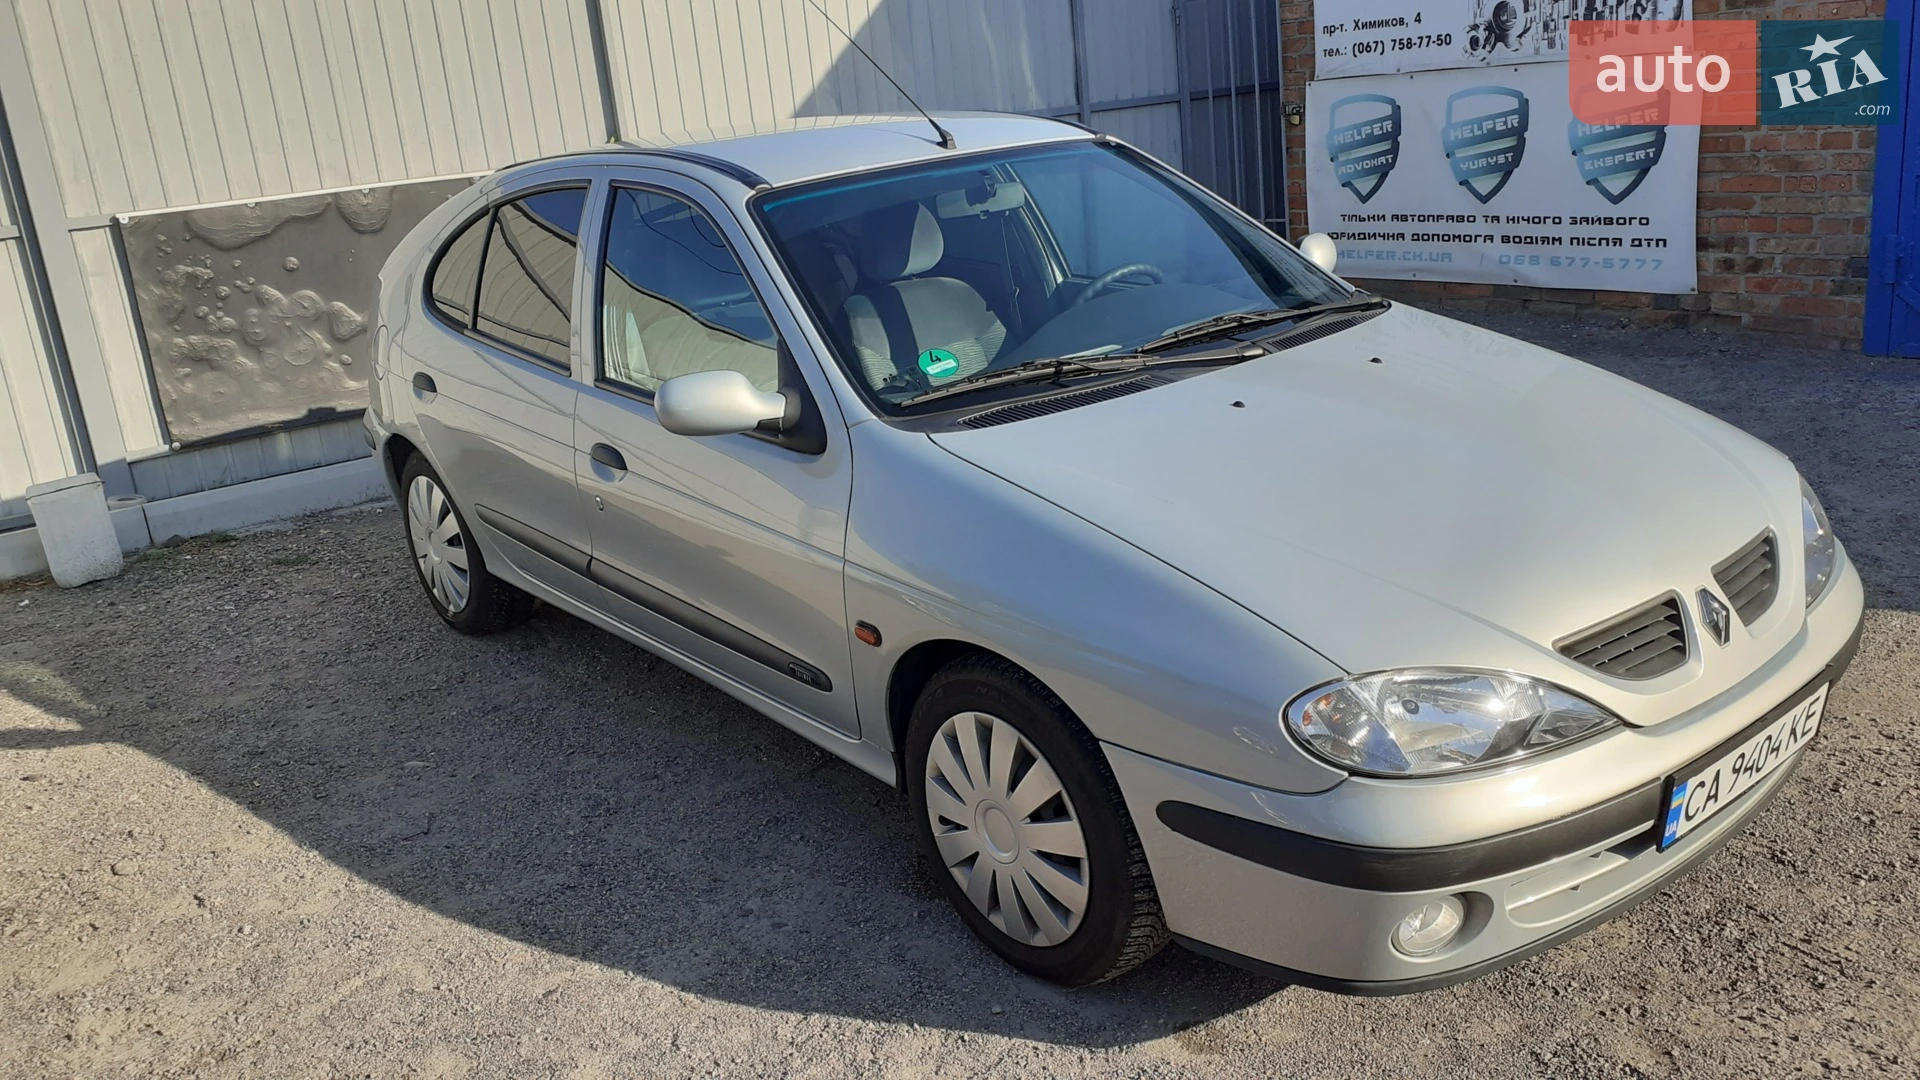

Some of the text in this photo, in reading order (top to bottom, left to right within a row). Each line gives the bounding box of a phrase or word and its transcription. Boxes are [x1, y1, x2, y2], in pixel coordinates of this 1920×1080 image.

[1322, 12, 1422, 37] пр-т. Химиков, 4
[1323, 33, 1452, 58] тел.: (067) 758-77-50
[1334, 120, 1393, 144] HELPER
[1450, 114, 1519, 141] HELPER
[1338, 154, 1394, 174] ADVOKAT
[1460, 152, 1514, 171] YURYST
[1584, 148, 1656, 170] EKSPERT
[1391, 214, 1477, 224] АВТОПРАВО
[1482, 214, 1501, 225] ТА
[1506, 215, 1563, 225] НІЧОГО
[1569, 214, 1650, 226] ЗАЙВОГО
[1411, 233, 1494, 244] ДОПОМОГА
[1501, 235, 1562, 246] ВОДІЯМ
[1630, 238, 1668, 248] ДТП
[1498, 254, 1541, 266] 068
[1549, 255, 1663, 271] 677-5777
[1685, 694, 1822, 822] CA 9404 KE
[1665, 820, 1678, 837] UA
